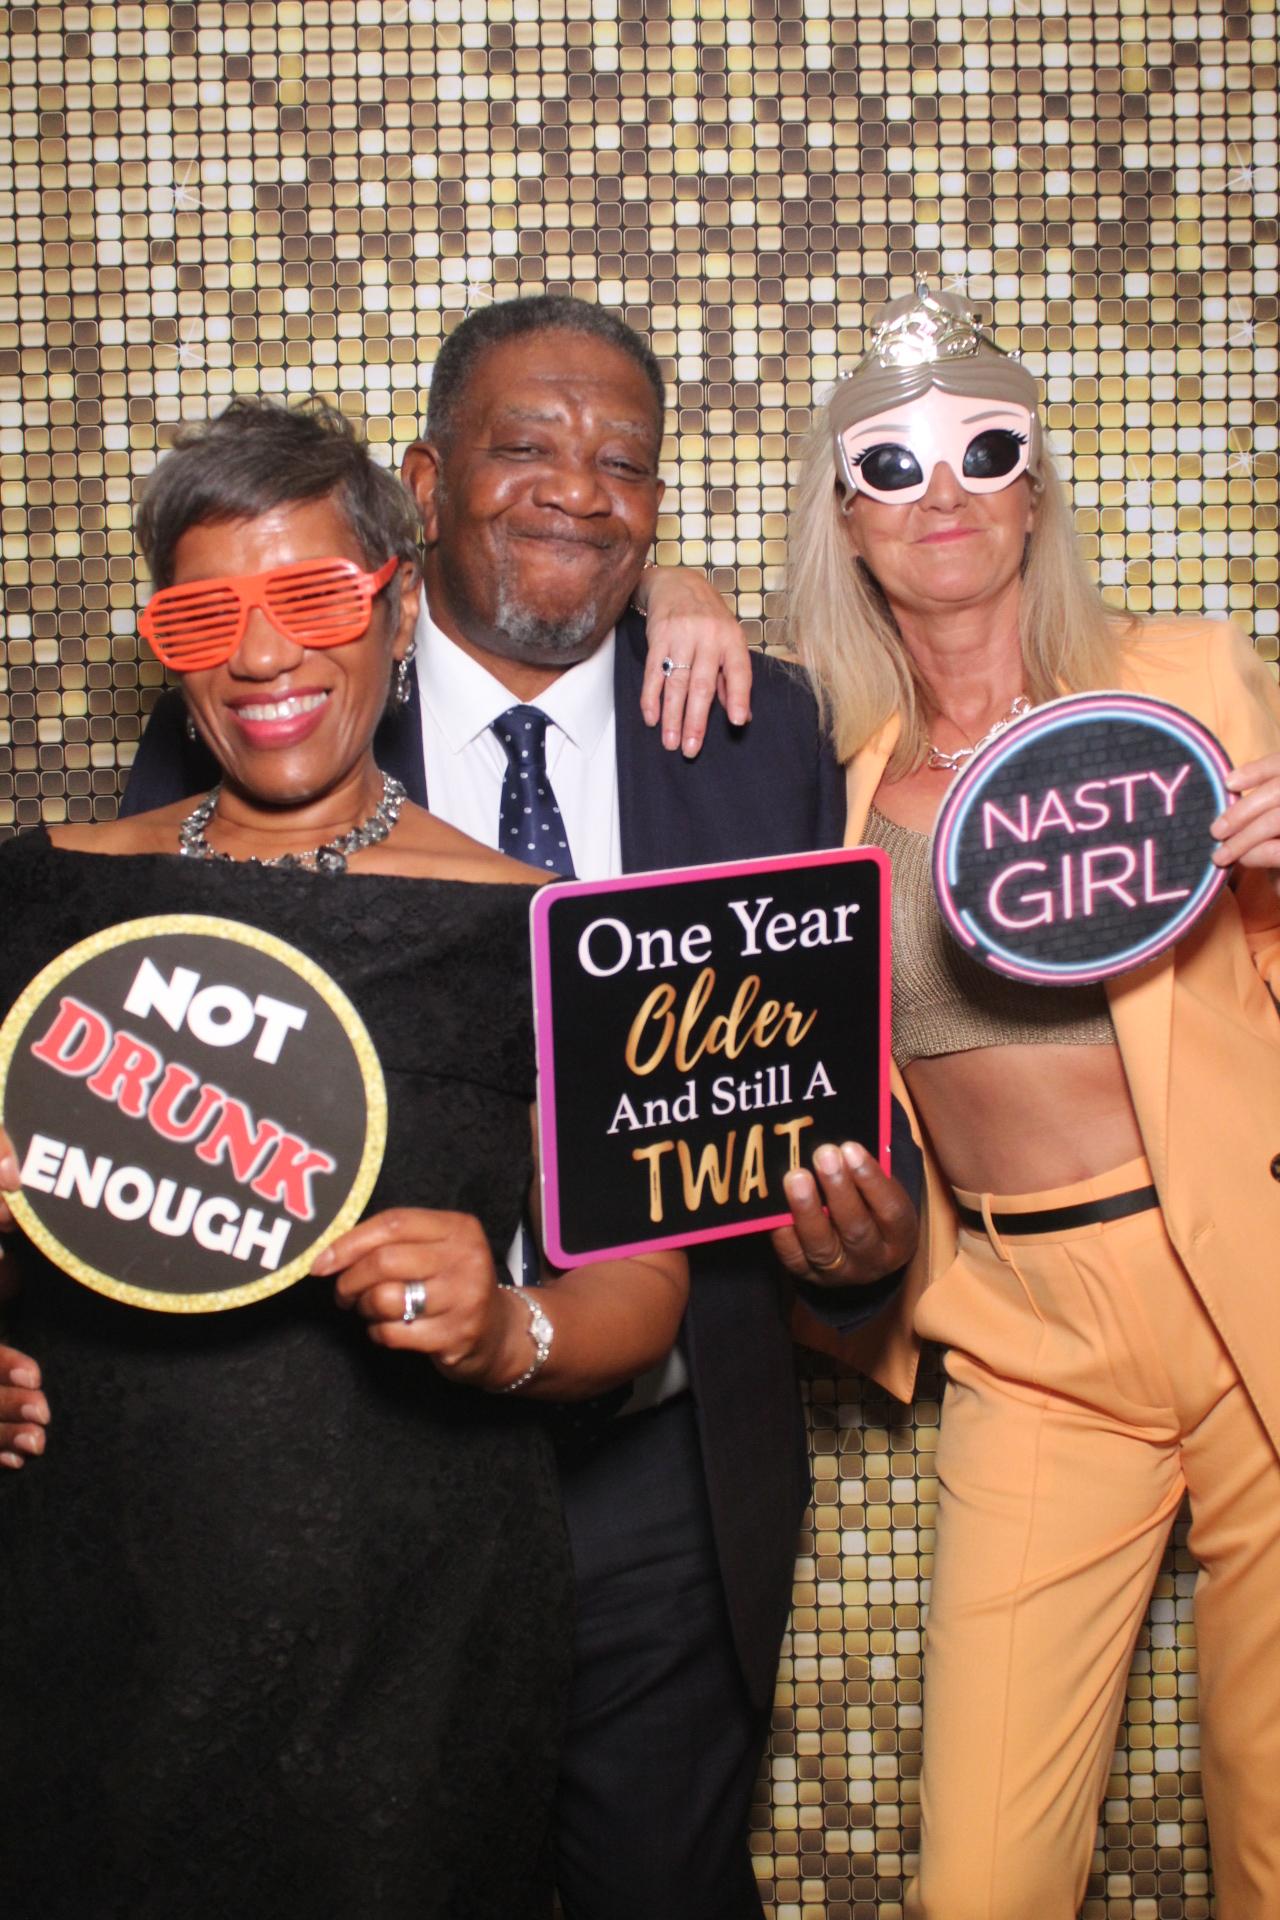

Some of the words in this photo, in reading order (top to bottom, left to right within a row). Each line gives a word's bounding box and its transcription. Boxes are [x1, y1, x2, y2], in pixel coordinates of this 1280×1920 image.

[982, 764, 1190, 849] NASTY
[578, 918, 712, 977] One
[728, 897, 860, 956] Year
[988, 839, 1190, 929] GIRL
[123, 957, 307, 1065] NOT
[625, 967, 817, 1075] Older
[31, 997, 336, 1221] DRUNK
[607, 1080, 699, 1134] And
[712, 1065, 793, 1116] Still
[803, 1061, 837, 1100] A
[20, 1134, 291, 1270] ENOUGH
[632, 1116, 814, 1222] TWAT
